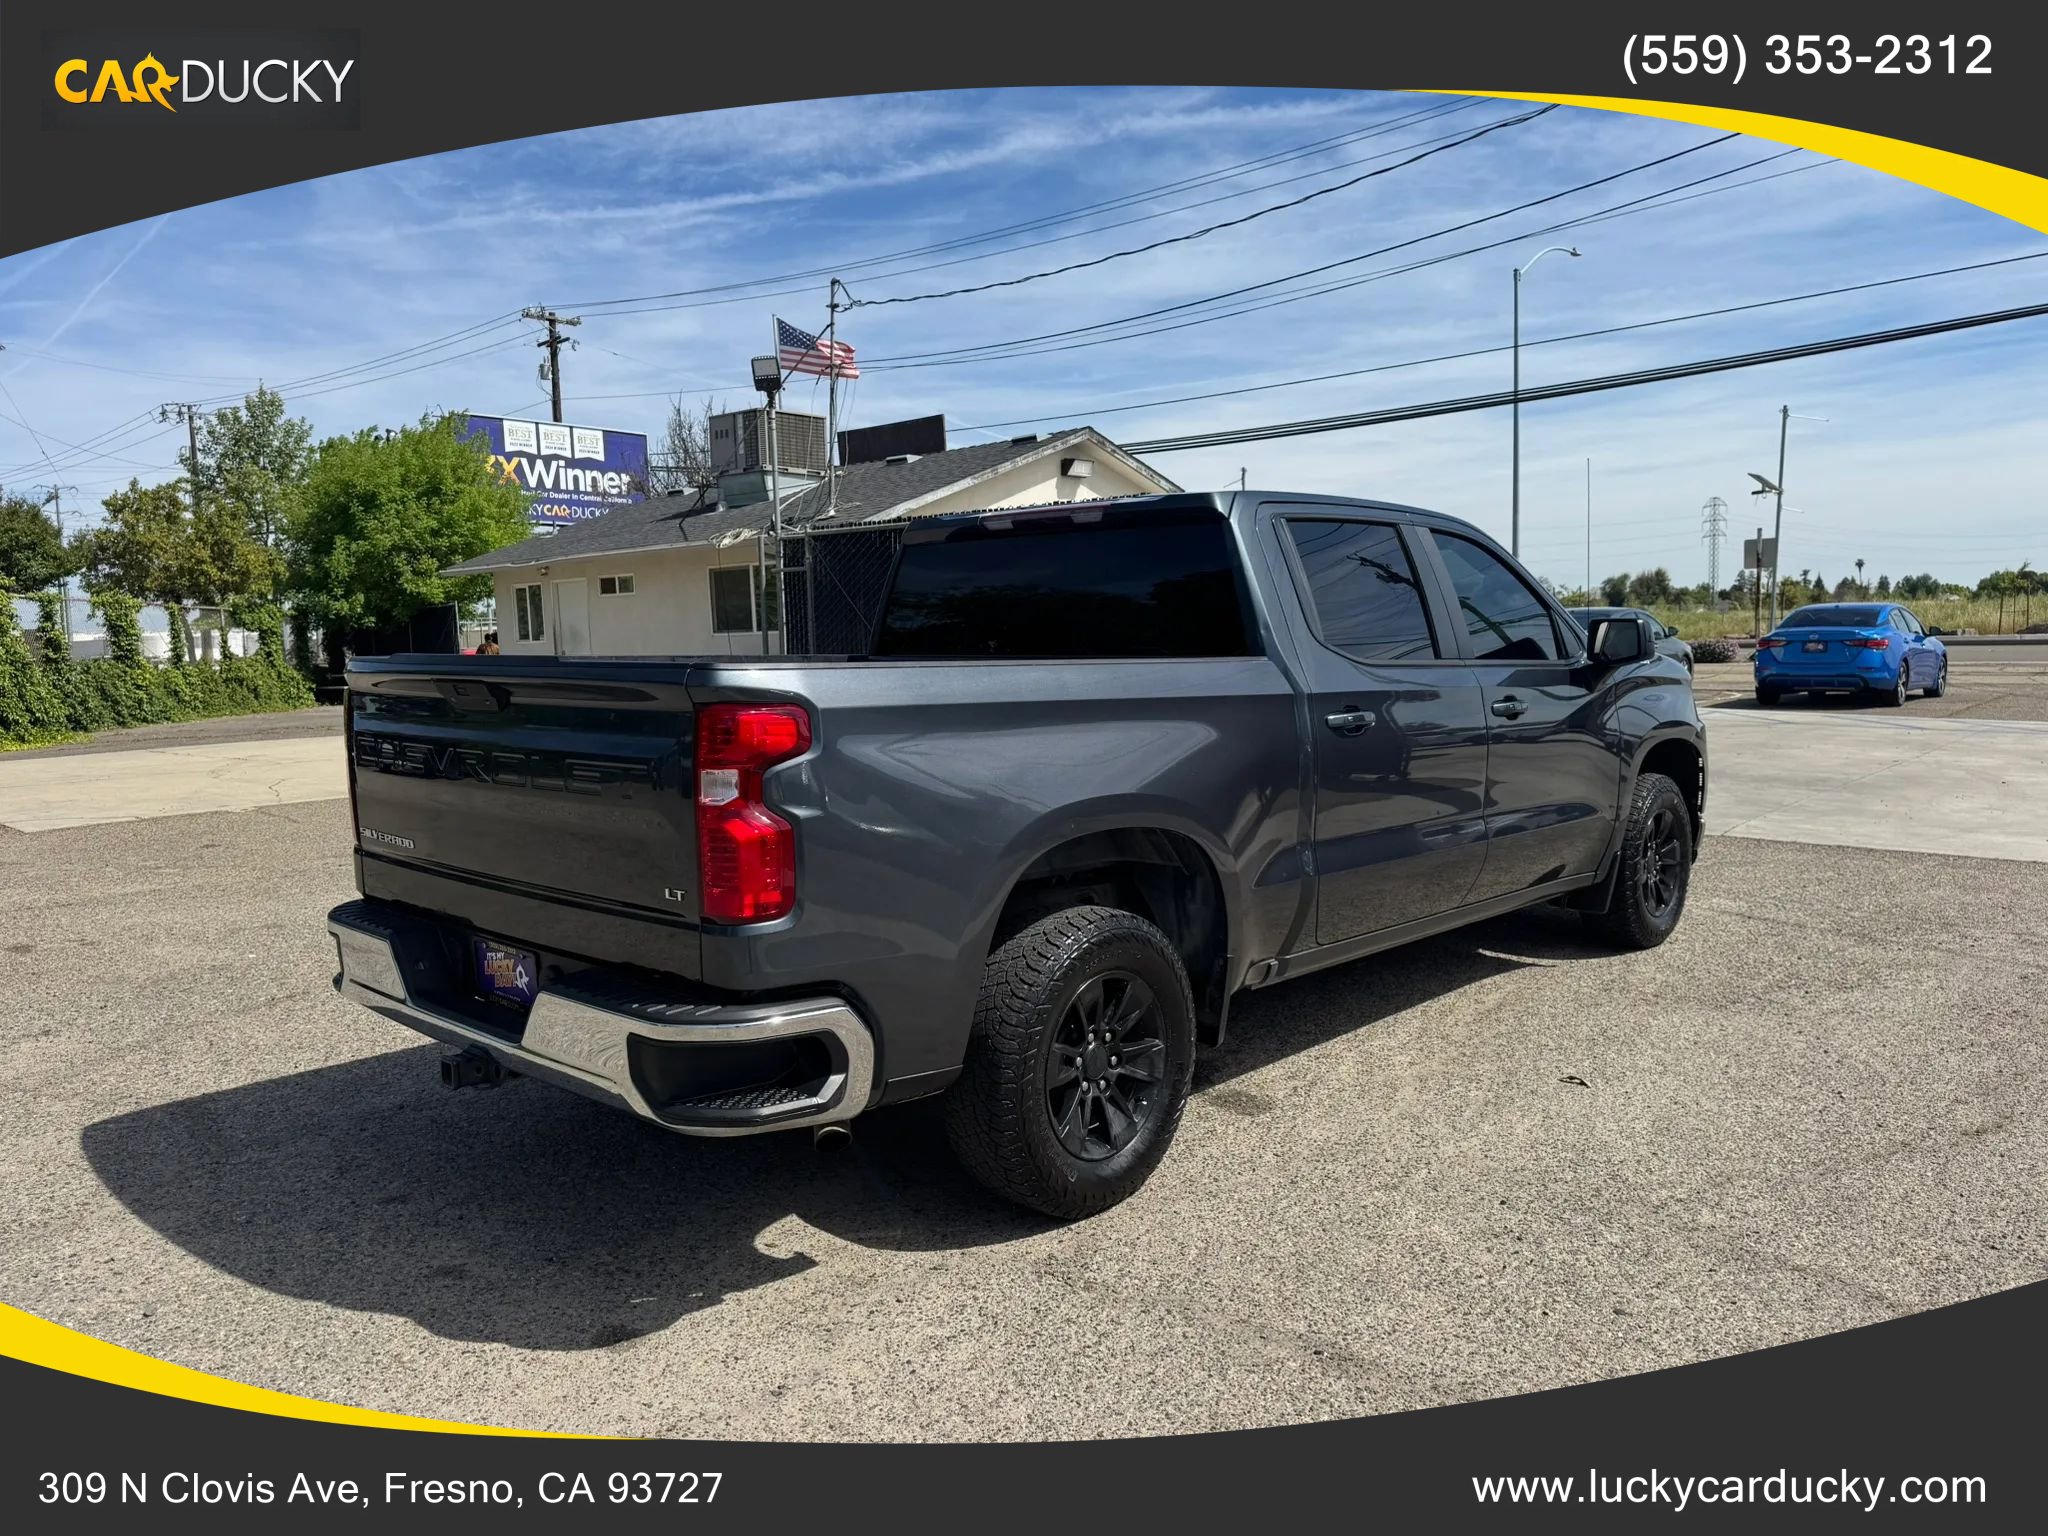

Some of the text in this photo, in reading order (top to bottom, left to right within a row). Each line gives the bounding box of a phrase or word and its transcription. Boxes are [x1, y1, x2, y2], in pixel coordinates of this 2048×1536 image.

[508, 428, 533, 439] BEST
[543, 431, 567, 442] BEST
[577, 435, 601, 446] BEST
[549, 491, 571, 500] Dealer
[579, 493, 603, 503] Central
[360, 827, 415, 849] SILVERADO
[664, 887, 686, 902] LT
